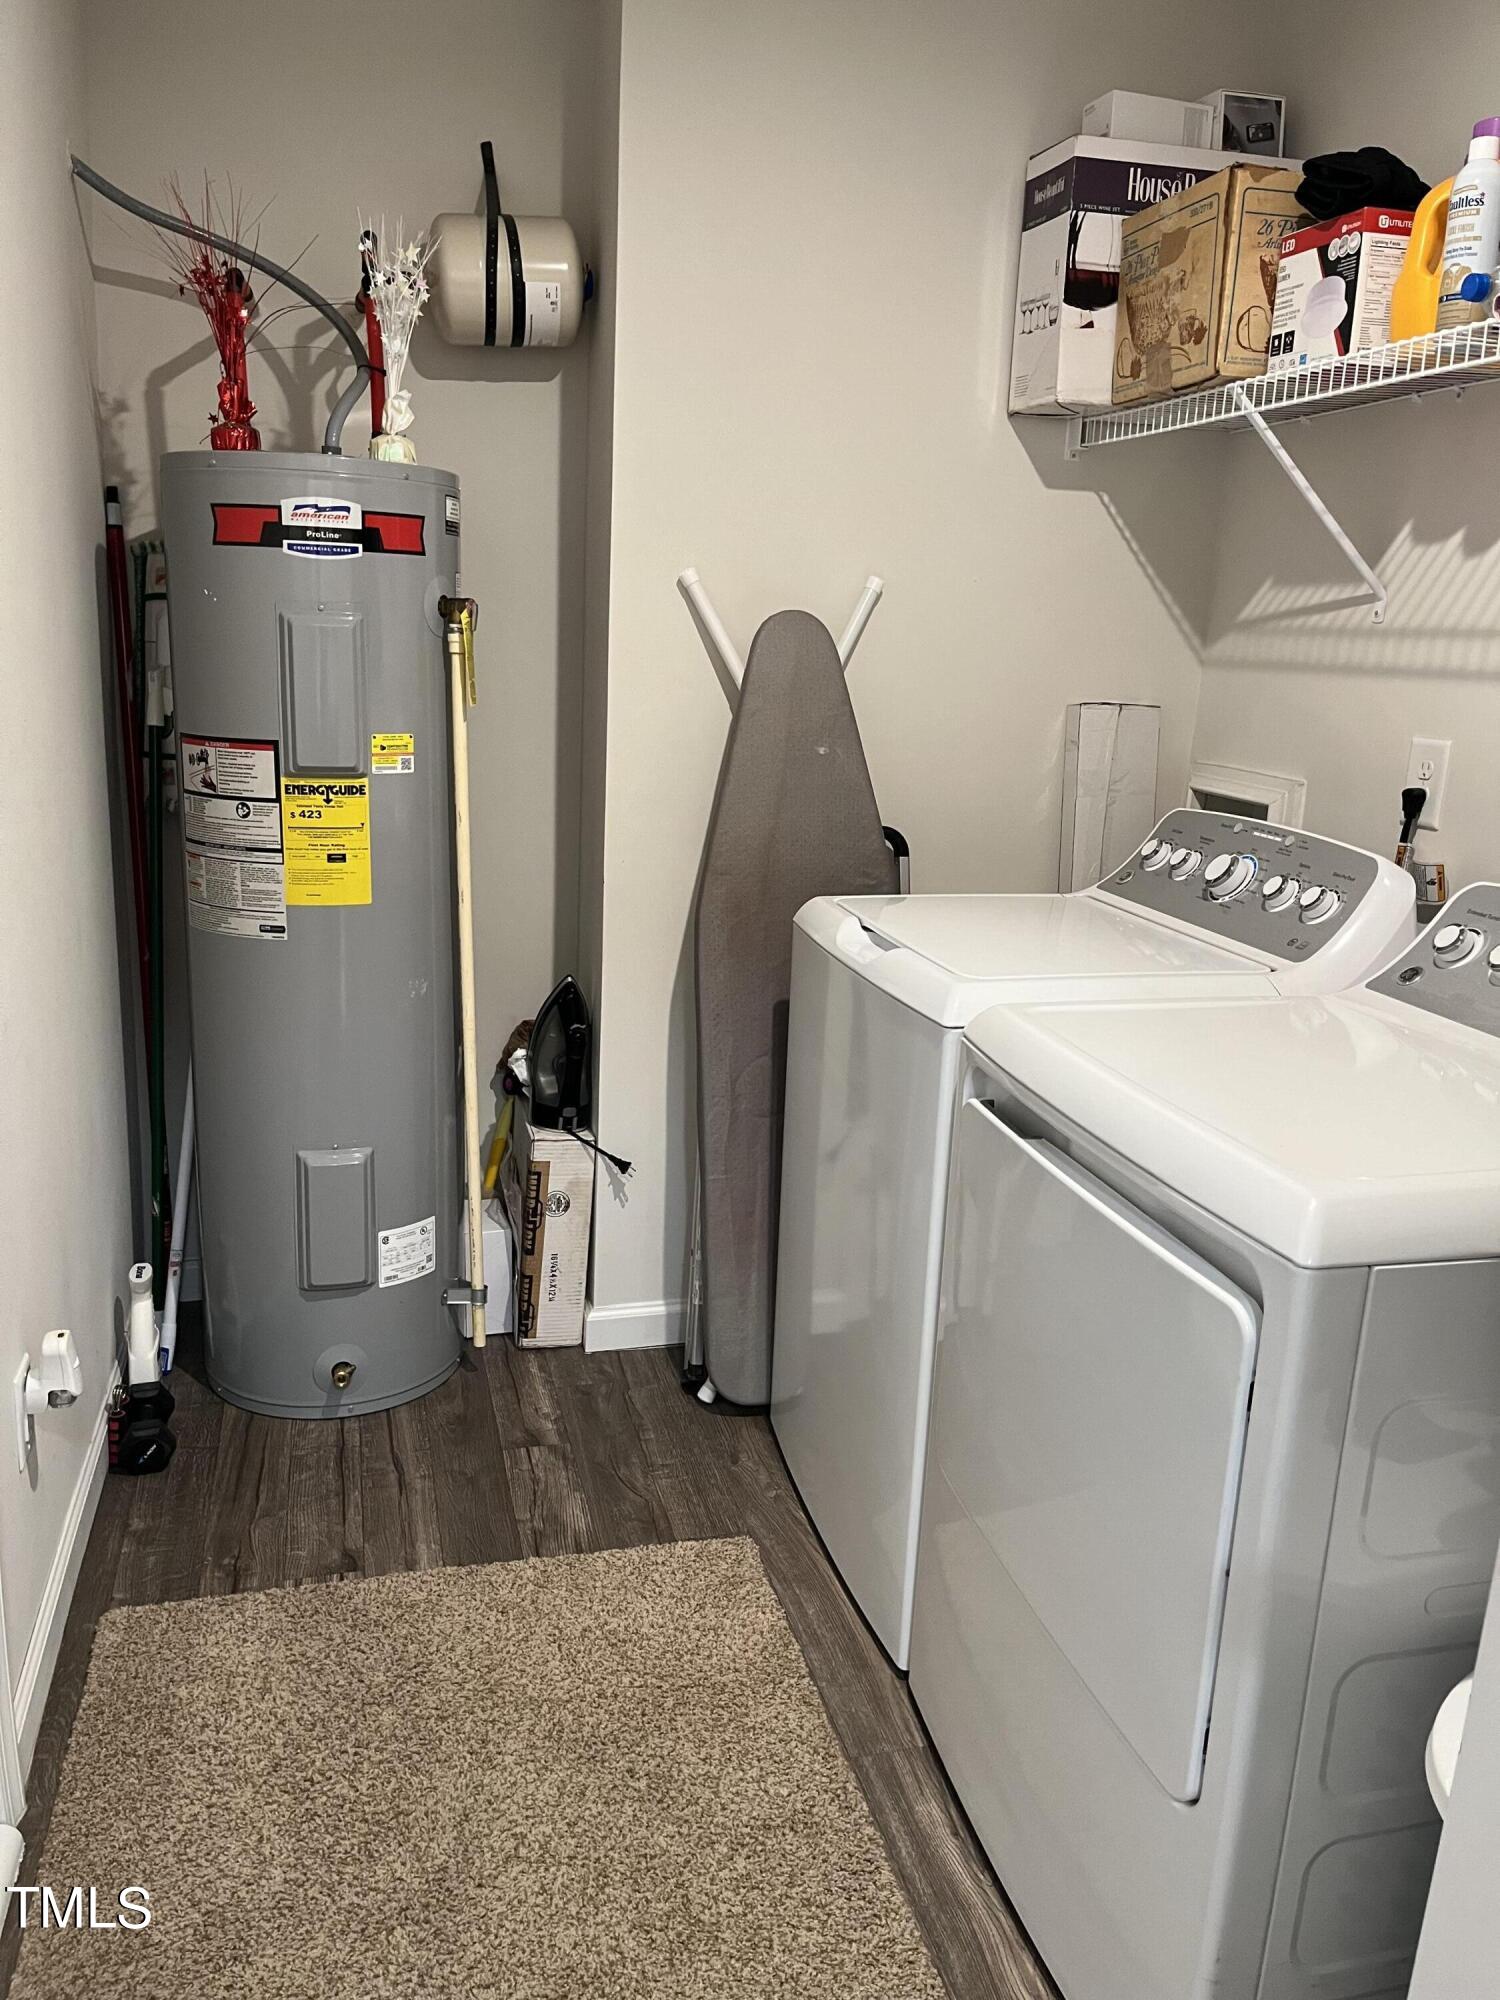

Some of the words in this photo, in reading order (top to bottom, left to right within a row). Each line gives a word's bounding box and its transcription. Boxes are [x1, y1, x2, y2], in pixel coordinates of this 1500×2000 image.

[1127, 167, 1182, 203] House
[1282, 239, 1296, 254] LED
[290, 511, 349, 520] american
[306, 530, 339, 539] ProLine
[299, 810, 322, 819] 423
